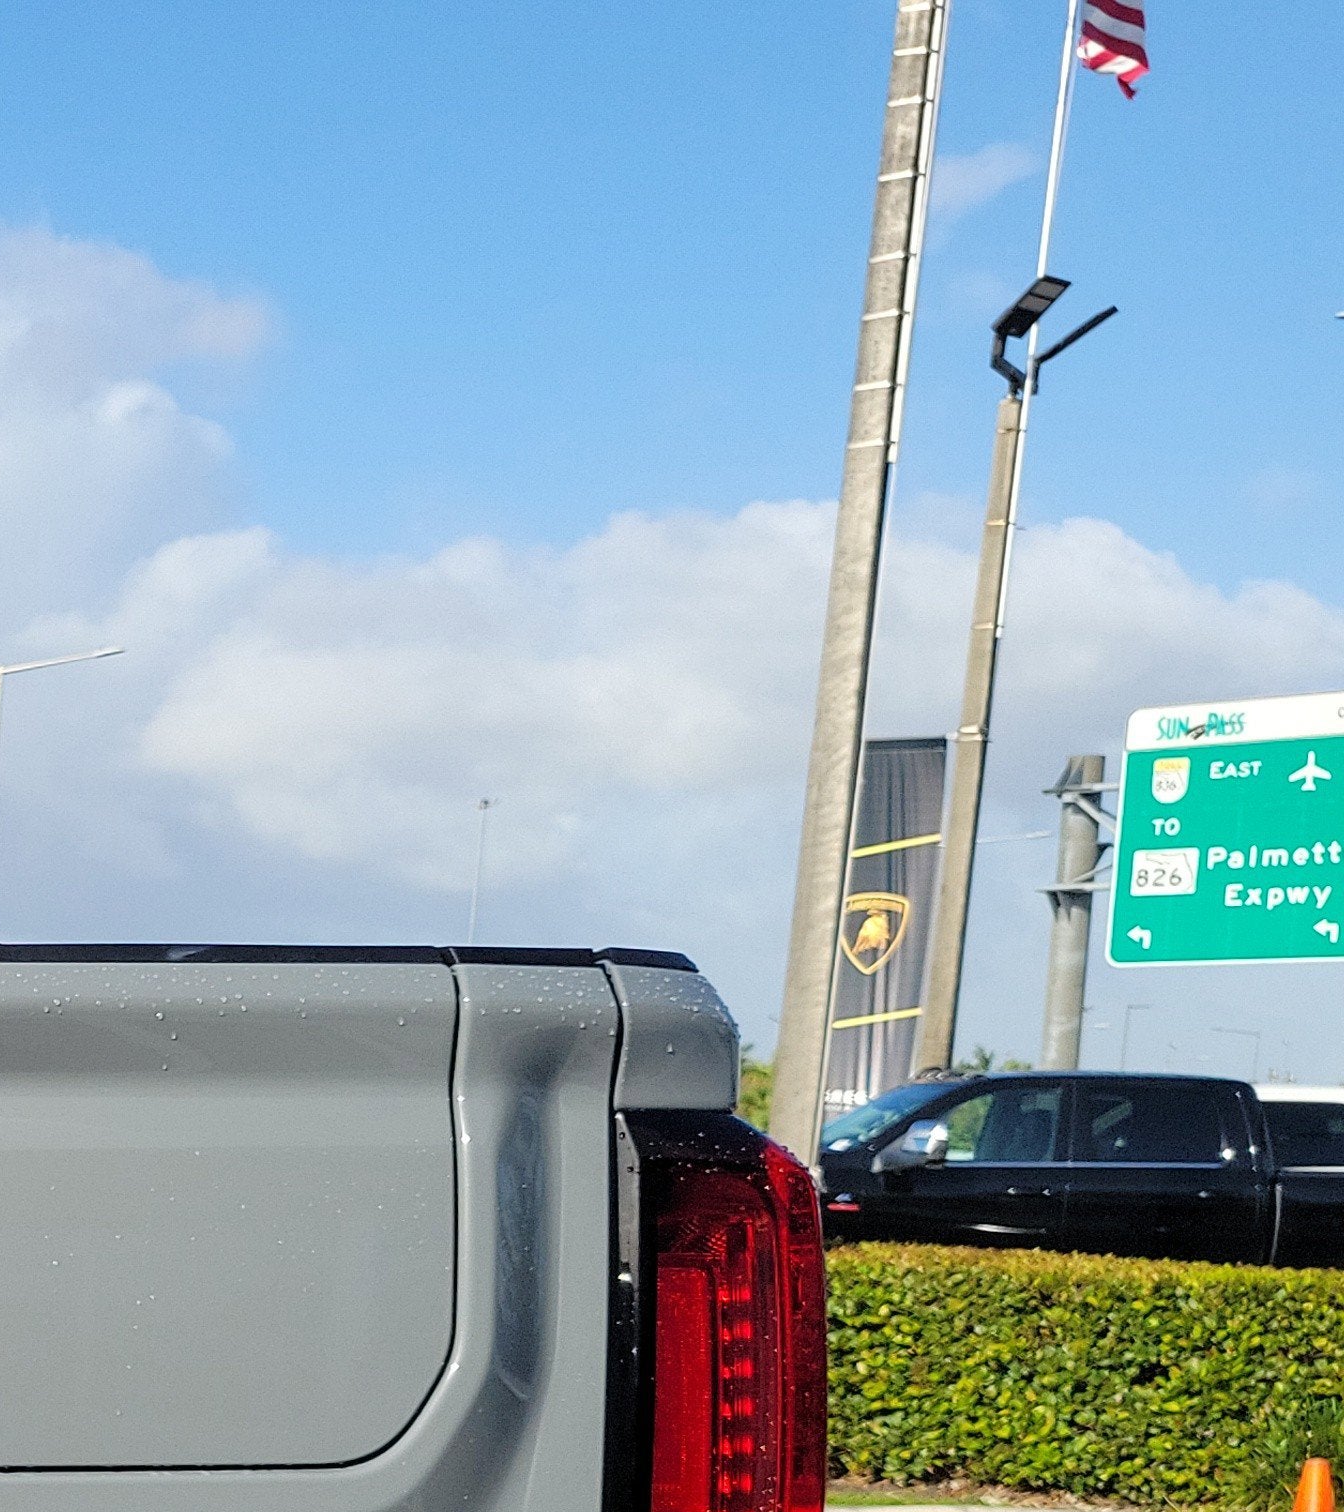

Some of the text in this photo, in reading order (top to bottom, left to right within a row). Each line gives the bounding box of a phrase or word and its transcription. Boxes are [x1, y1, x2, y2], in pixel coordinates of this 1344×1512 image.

[1156, 716, 1189, 740] SUN
[1209, 760, 1262, 779] EAST
[1152, 817, 1180, 836] TO
[1136, 869, 1182, 888] 826
[1224, 883, 1332, 910] Expwy
